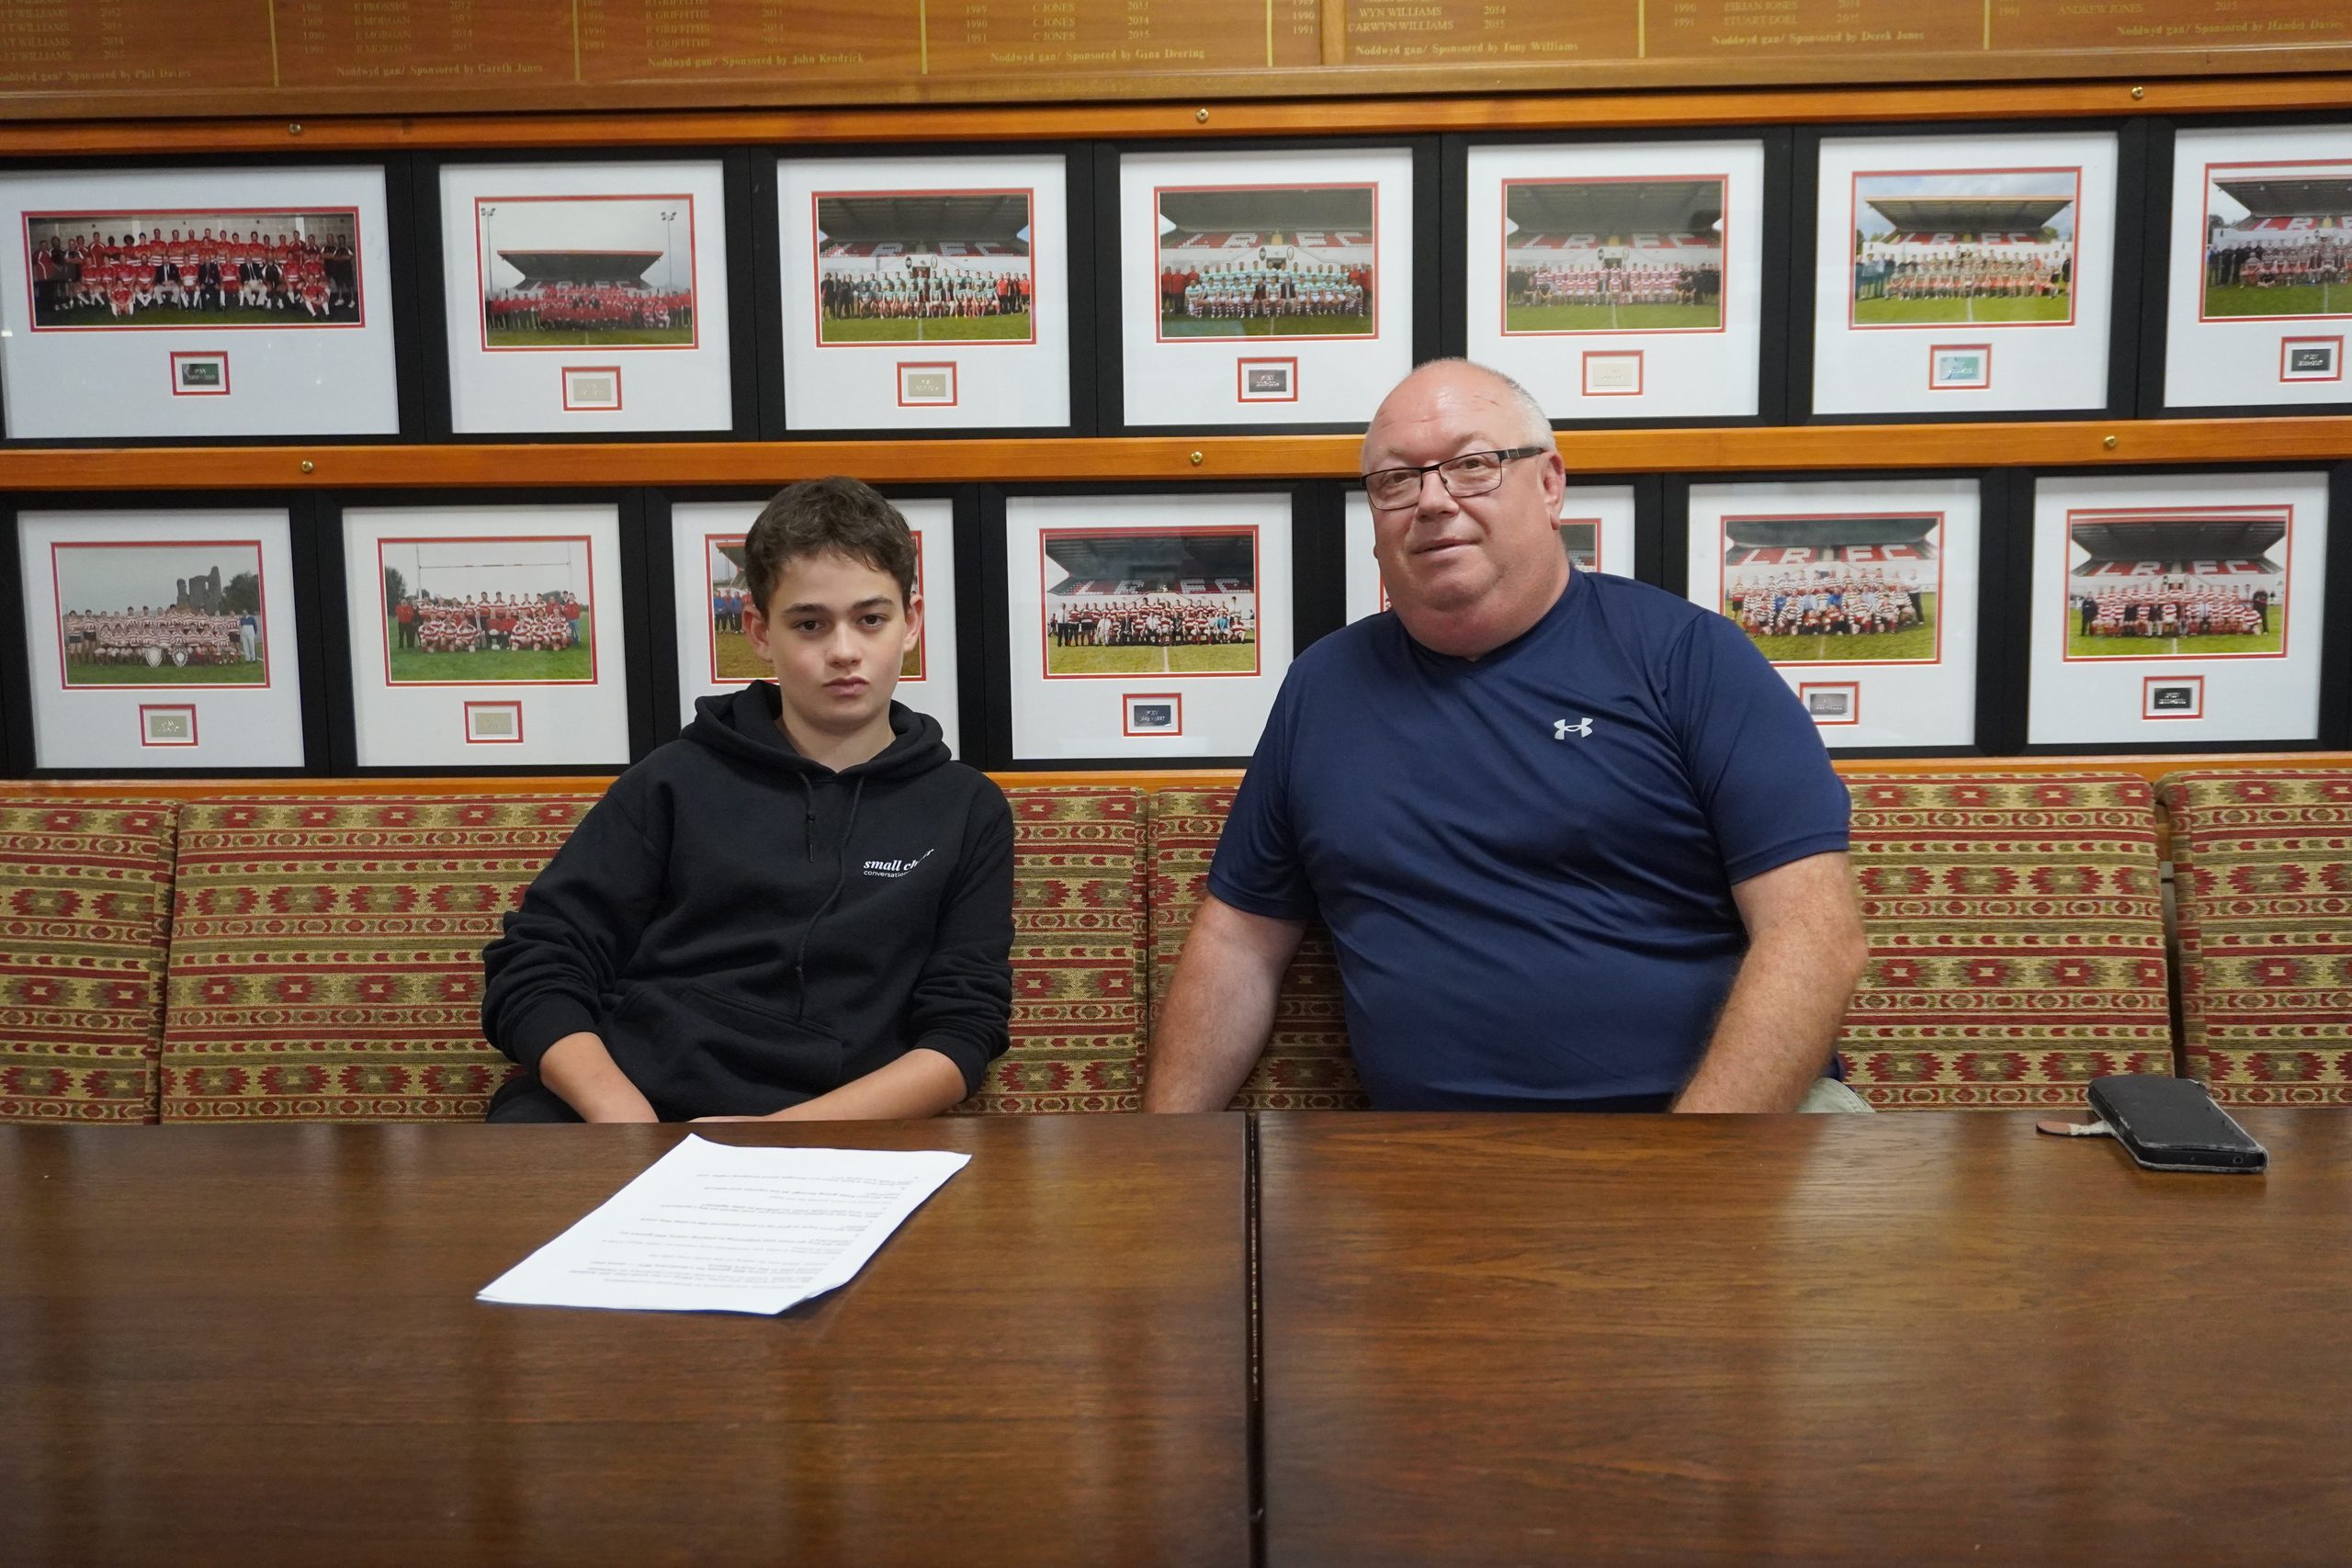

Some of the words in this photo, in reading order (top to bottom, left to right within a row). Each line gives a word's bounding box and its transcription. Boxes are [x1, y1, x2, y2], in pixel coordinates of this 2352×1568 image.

[966, 5, 988, 14] 1989
[1042, 2, 1075, 12] JONES
[1484, 6, 1507, 16] 2014
[1674, 3, 1697, 13] 1990
[1765, 1, 1798, 11] JONES
[2057, 5, 2105, 15] ANDREW
[2109, 4, 2143, 14] JONES
[1293, 11, 1316, 20] 1990
[1359, 8, 1385, 17] WYN
[1387, 6, 1442, 17] WILLIAMS
[1997, 6, 2019, 17] 1991
[364, 15, 411, 26] MORGAN
[967, 19, 989, 28] 1990
[1043, 17, 1076, 27] JONES
[1127, 16, 1149, 26] 2014
[1674, 17, 1695, 28] 1991
[1723, 15, 1767, 26] STUART
[1293, 25, 1314, 34] 1991
[1347, 22, 1396, 32] CARWYN
[1398, 20, 1454, 30] WILLIAMS
[2117, 26, 2163, 37] Noddwyd
[2165, 24, 2191, 36] gan/
[2194, 22, 2247, 35] Sponsored
[2252, 22, 2262, 33] by
[365, 29, 411, 39] MORGAN
[967, 33, 988, 43] 1991
[1043, 31, 1076, 41] JONES
[1127, 29, 1150, 40] 2015
[1713, 34, 1758, 47] Noddwyd
[1760, 34, 1786, 46] gan/
[1789, 31, 1841, 45] Sponsored
[1846, 31, 1857, 42] by
[1861, 30, 1892, 41] Derek
[1895, 29, 1925, 40] Jones
[17, 37, 71, 47] WILLIAMS
[365, 43, 412, 53] MORGAN
[1355, 45, 1400, 57] Noddwyd
[1403, 44, 1428, 56] gan/
[1431, 42, 1484, 55] Sponsored
[1488, 42, 1498, 53] by
[1503, 42, 1526, 53] Tony
[1531, 40, 1578, 51] Williams
[18, 51, 73, 61] WILLIAMS
[648, 57, 692, 68] Noddwyd
[694, 56, 719, 68] gan/
[721, 55, 772, 67] Sponsored
[776, 55, 787, 66] by
[792, 53, 815, 64] John
[819, 52, 864, 63] Kendrick
[989, 52, 1035, 64] Noddwyd
[1038, 51, 1062, 63] gan/
[1066, 50, 1116, 62] Sponsored
[1121, 49, 1131, 61] by
[1136, 49, 1160, 59] Gina
[1164, 48, 1205, 60] Deering
[135, 68, 155, 79] Phil
[336, 66, 379, 77] Noddwyd
[410, 62, 459, 76] Sponsored
[464, 64, 474, 75] by
[478, 62, 512, 73] Gareth
[516, 62, 543, 73] Jones
[864, 860, 902, 871] small
